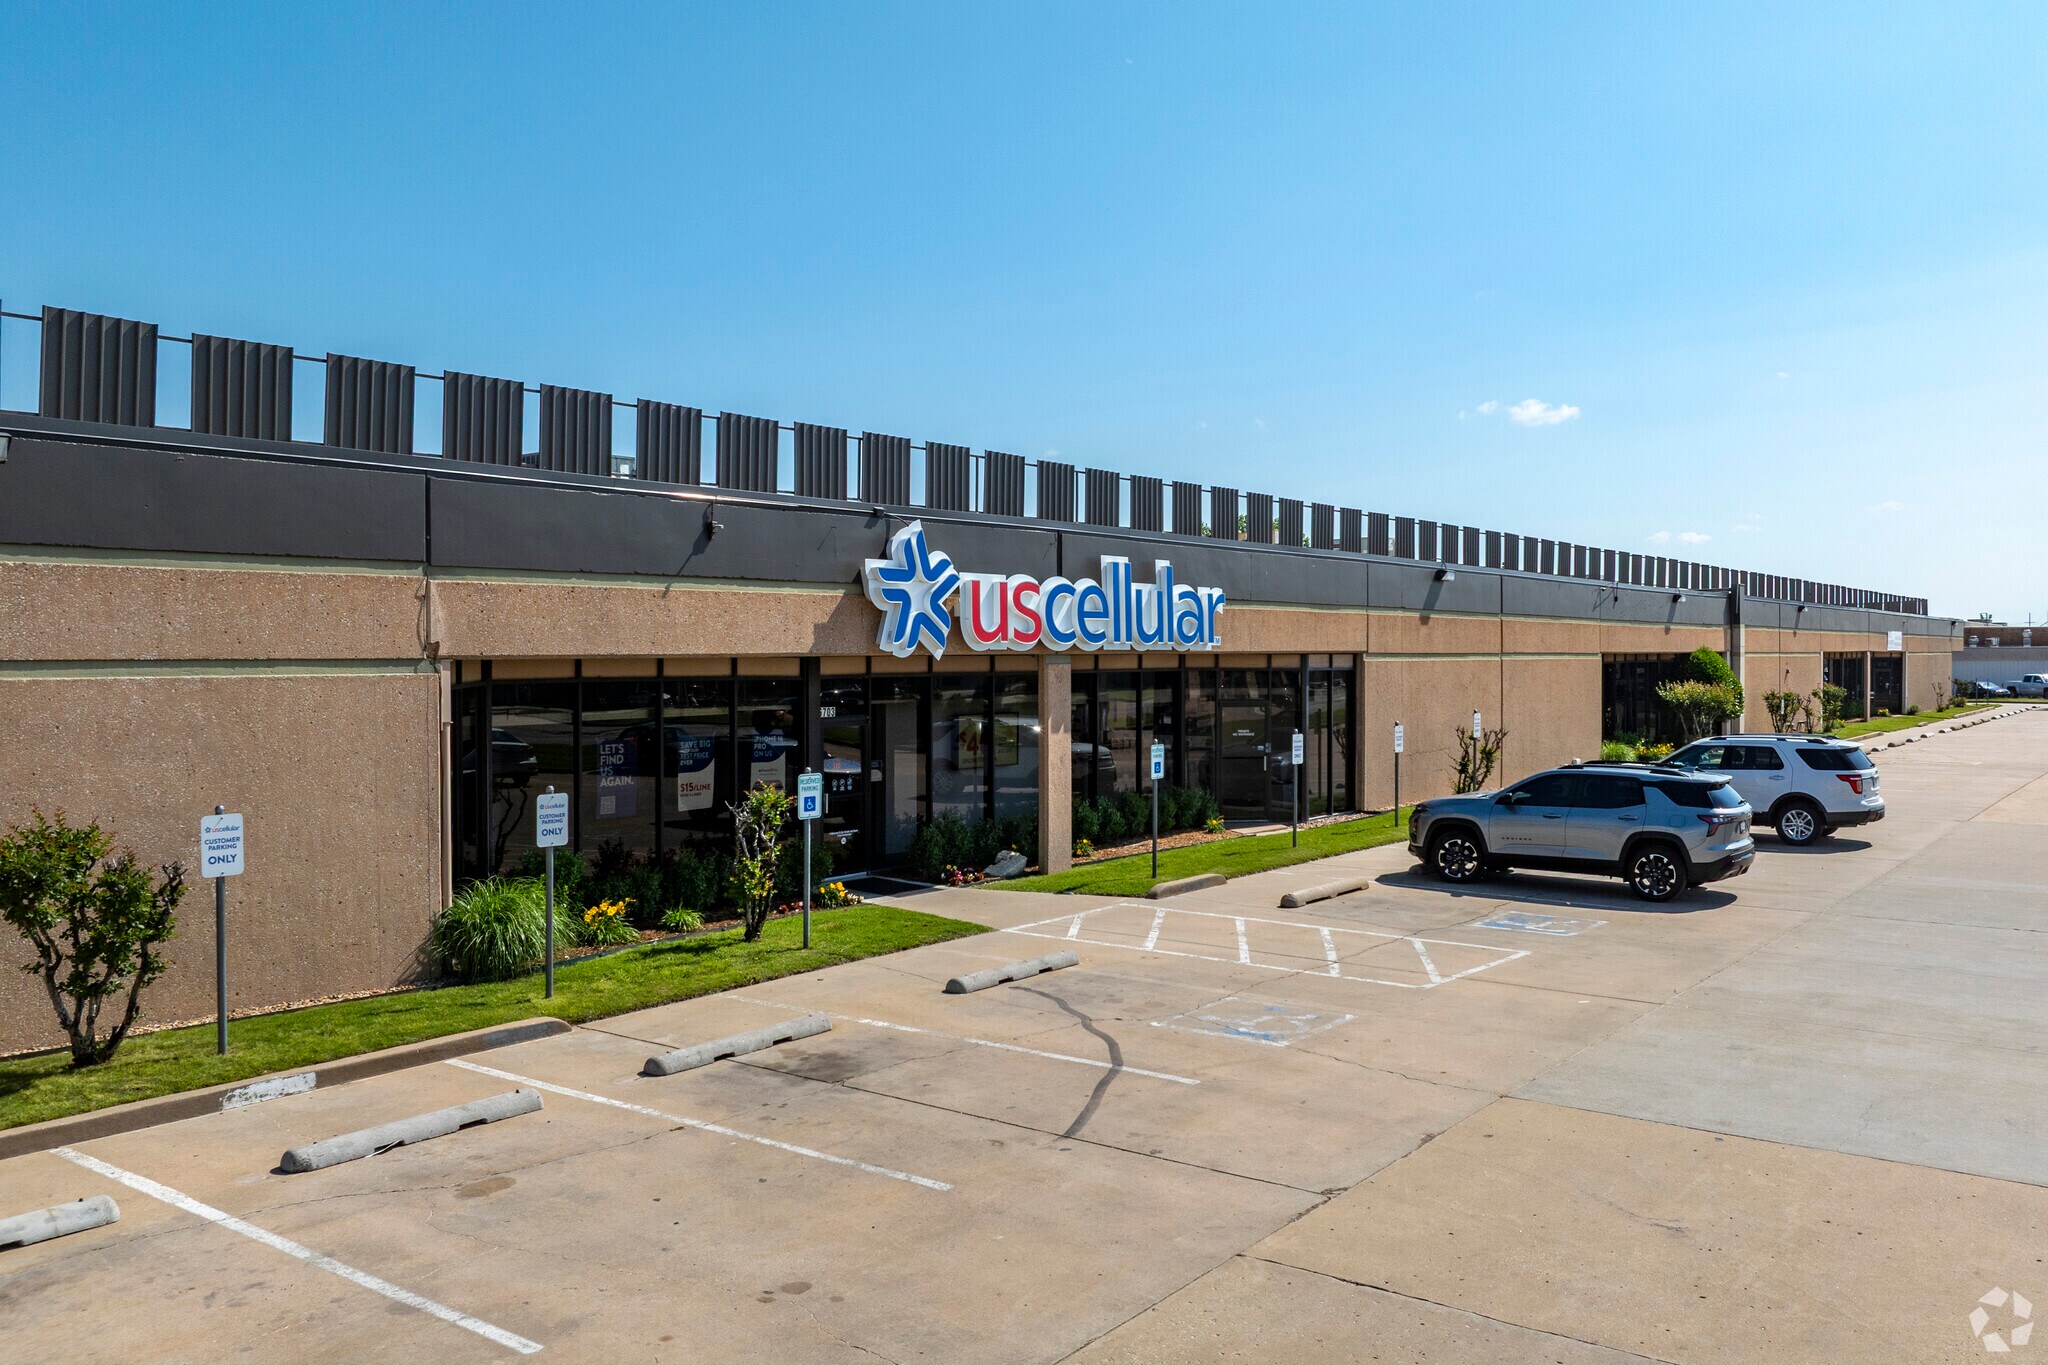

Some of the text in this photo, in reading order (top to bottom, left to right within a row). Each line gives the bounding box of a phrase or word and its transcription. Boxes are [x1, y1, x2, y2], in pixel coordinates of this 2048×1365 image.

[971, 561, 1225, 645] uscellular
[600, 743, 624, 754] LET'S
[699, 740, 711, 748] BIG
[600, 754, 624, 765] FIND
[600, 766, 613, 776] US
[600, 775, 634, 787] AGAIN.
[680, 782, 711, 793] $15/LINE
[541, 827, 563, 836] ONLY
[204, 836, 240, 845] CUSTOMER
[208, 843, 237, 851] PARKING
[208, 854, 237, 865] ONLY
